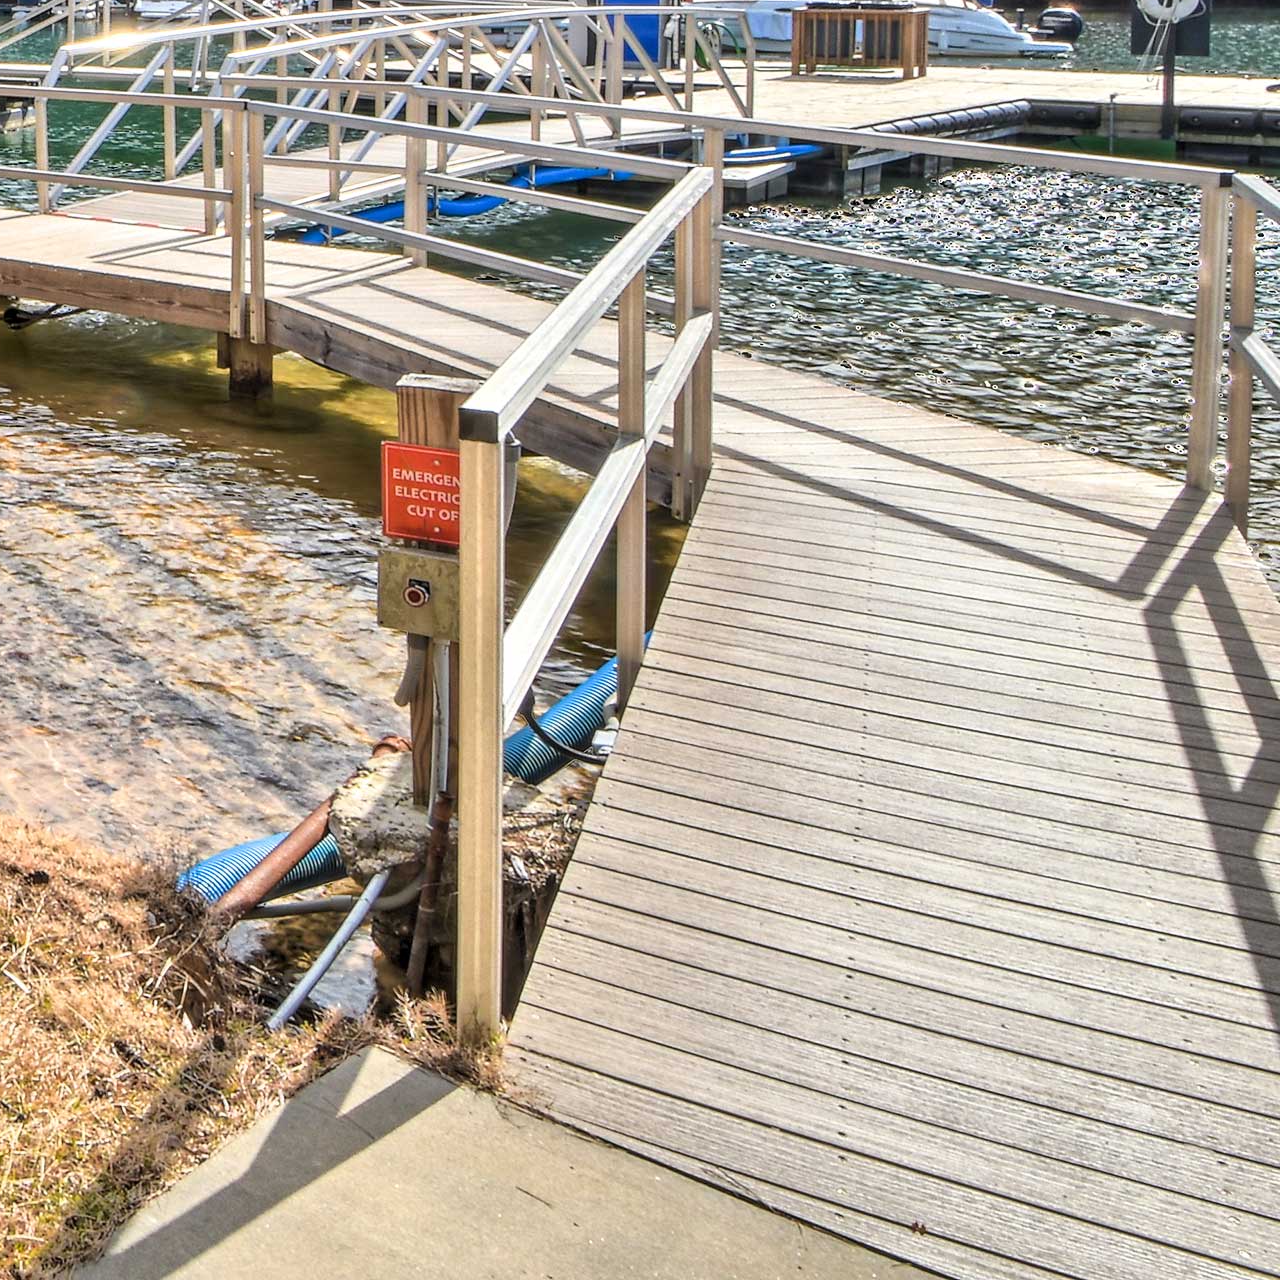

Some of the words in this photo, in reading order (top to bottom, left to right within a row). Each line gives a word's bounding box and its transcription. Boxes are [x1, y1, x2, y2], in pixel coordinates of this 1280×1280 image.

[392, 468, 460, 487] EMERGEN
[395, 485, 460, 505] ELECTRIC
[407, 504, 435, 518] CUT
[438, 509, 459, 521] OF
